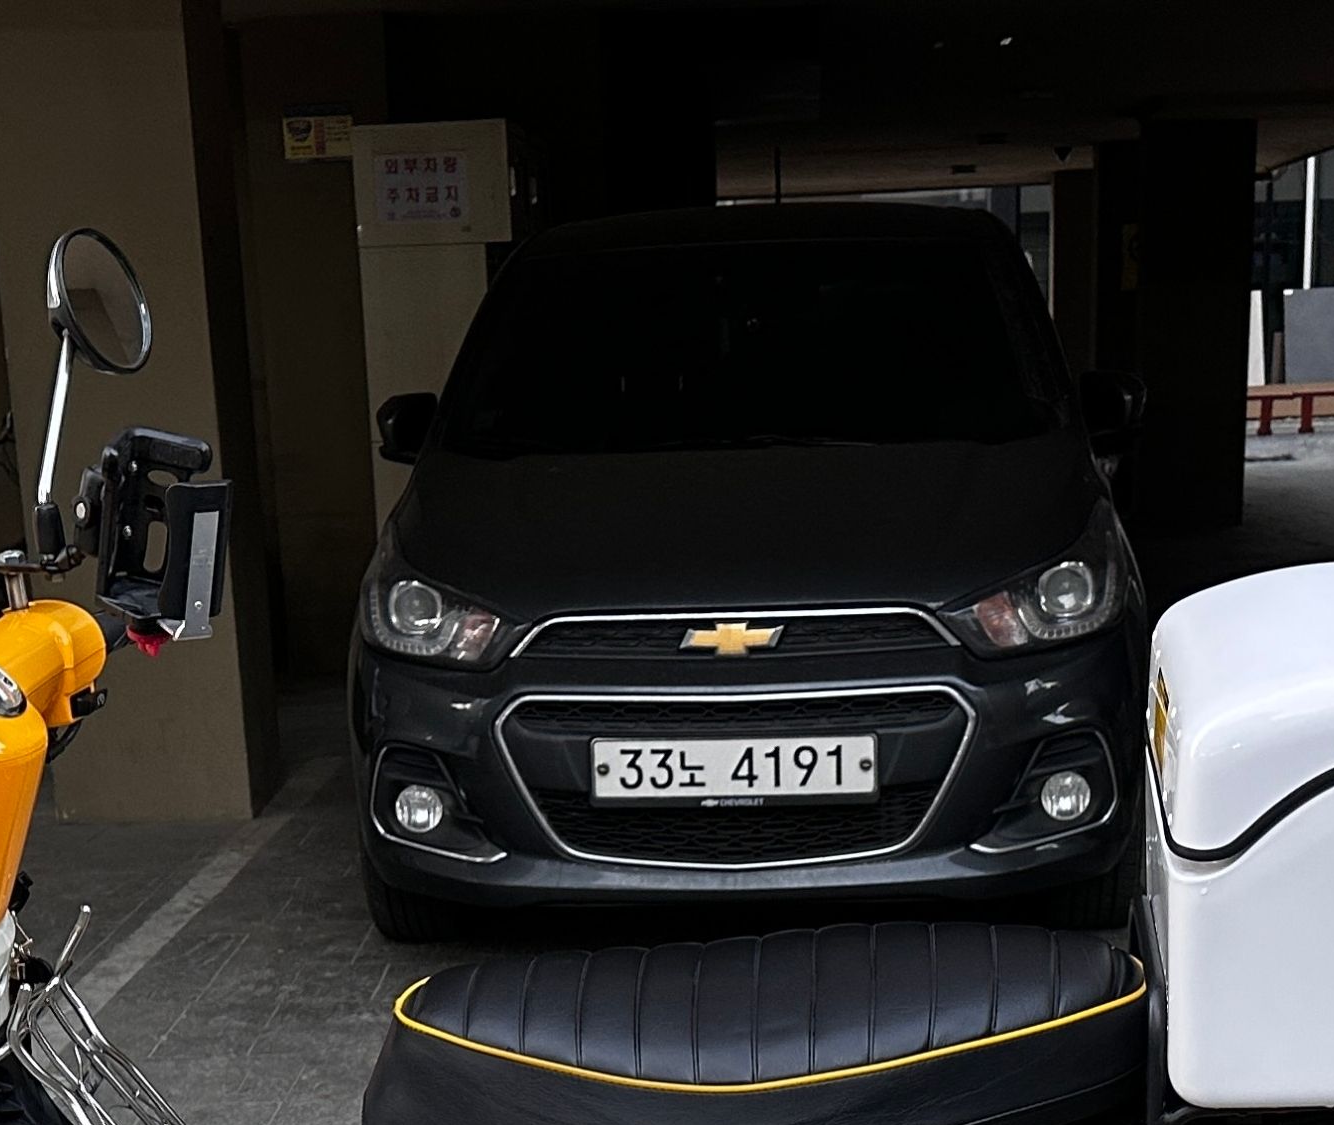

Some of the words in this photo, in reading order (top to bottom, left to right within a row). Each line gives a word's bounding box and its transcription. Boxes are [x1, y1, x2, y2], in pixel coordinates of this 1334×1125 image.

[386, 185, 459, 204] 주차금지
[618, 747, 706, 789] 33노
[730, 744, 845, 788] 4191
